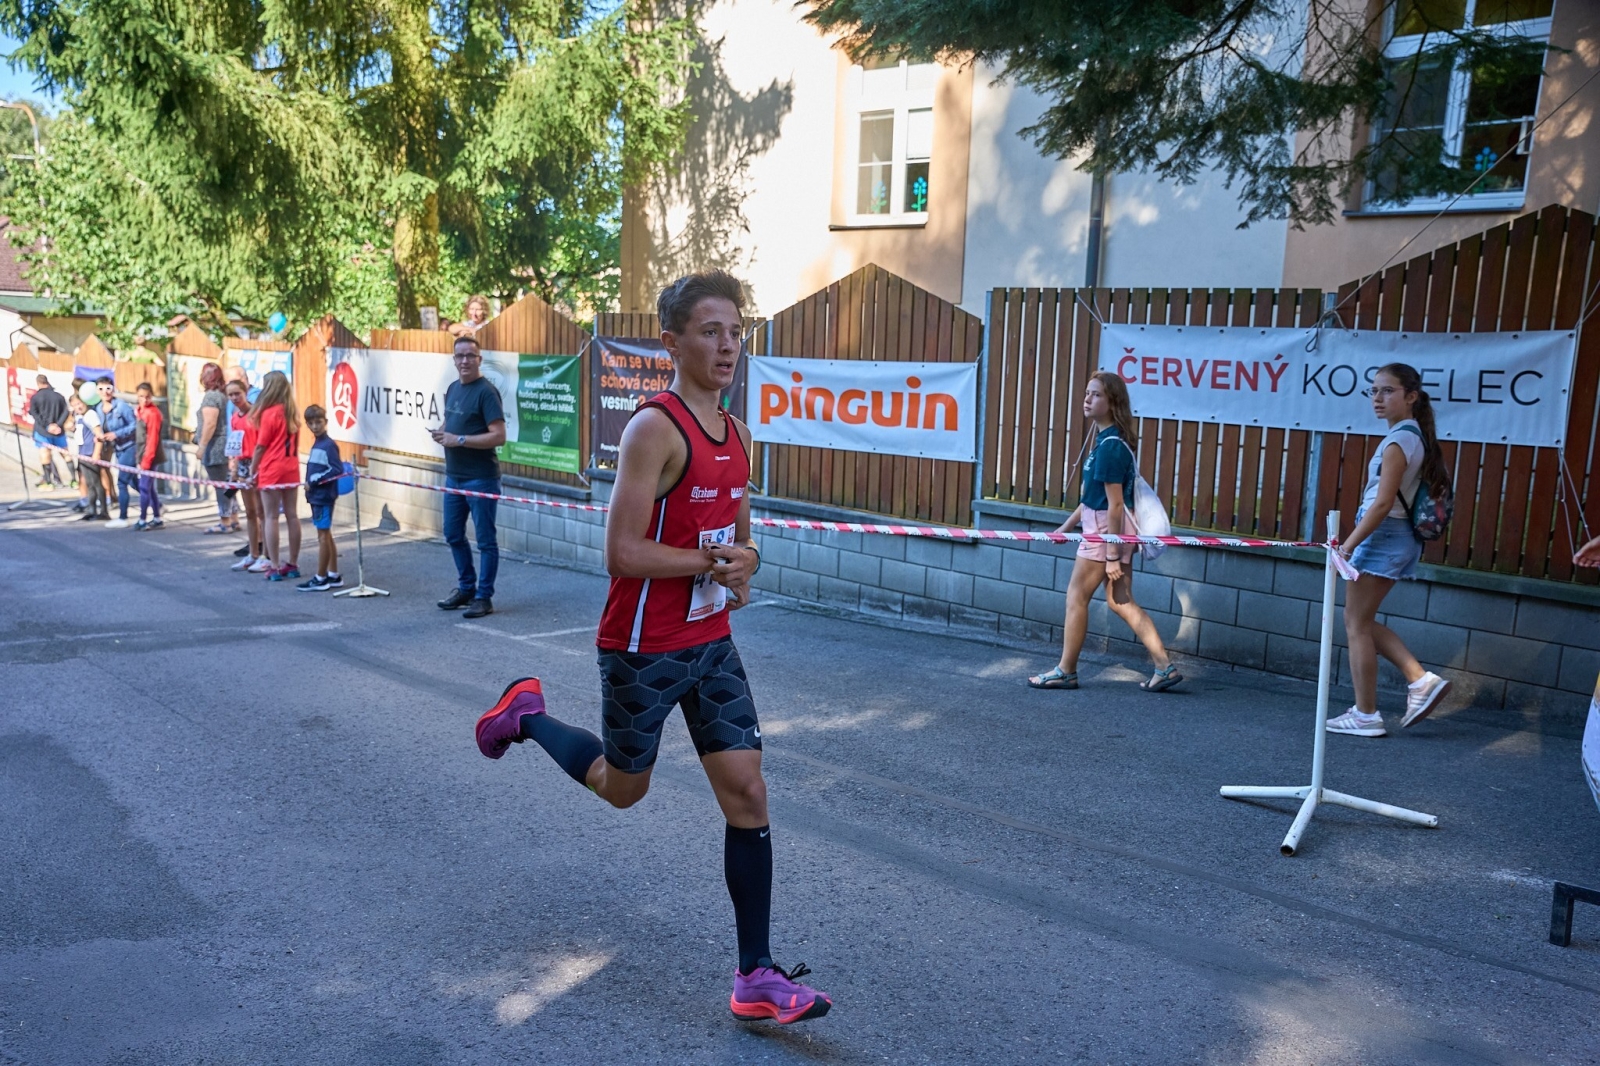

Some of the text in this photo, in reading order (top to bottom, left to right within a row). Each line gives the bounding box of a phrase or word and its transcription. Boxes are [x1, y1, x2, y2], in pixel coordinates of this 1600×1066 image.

[600, 350, 676, 370] Kam se v les
[545, 381, 571, 392] koncerty,
[601, 372, 669, 392] schová celý
[1116, 346, 1544, 407] ČERVENÝ KOSELEC
[364, 385, 446, 422] INTEGRA
[760, 370, 958, 431] pinguin
